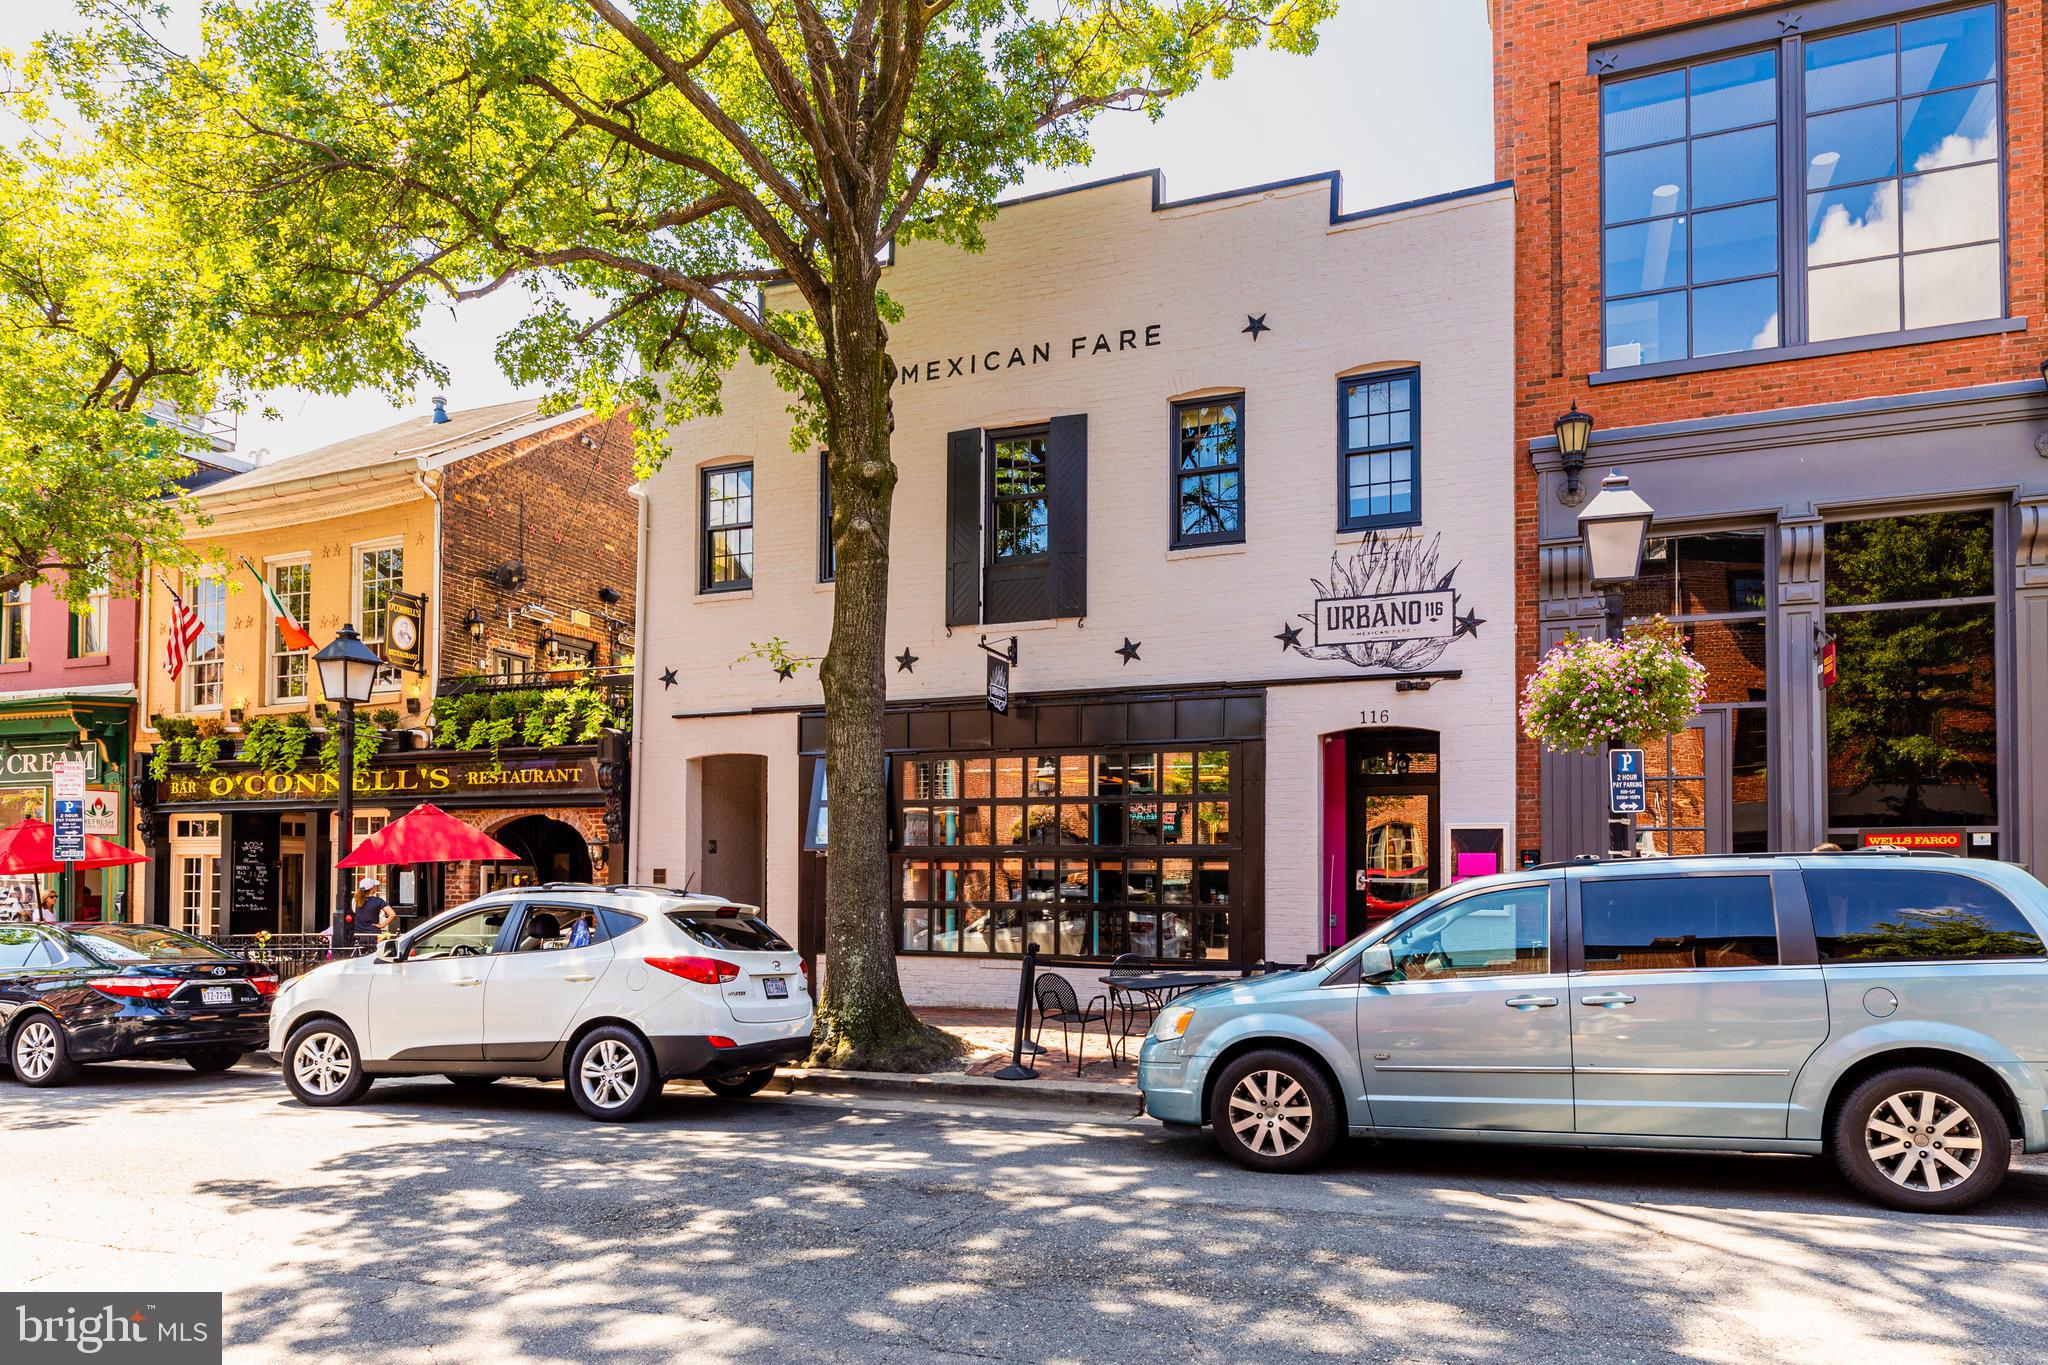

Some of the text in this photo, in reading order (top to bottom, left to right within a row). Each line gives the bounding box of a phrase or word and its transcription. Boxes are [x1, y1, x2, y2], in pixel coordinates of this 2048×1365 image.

[901, 324, 1161, 385] MEXICAN FARE
[1326, 600, 1444, 631] URBANO 116
[1360, 709, 1389, 724] 116
[171, 768, 583, 796] BAR O'CONNELL'S RESTAURANT
[1868, 835, 1957, 845] WELLS FARGO
